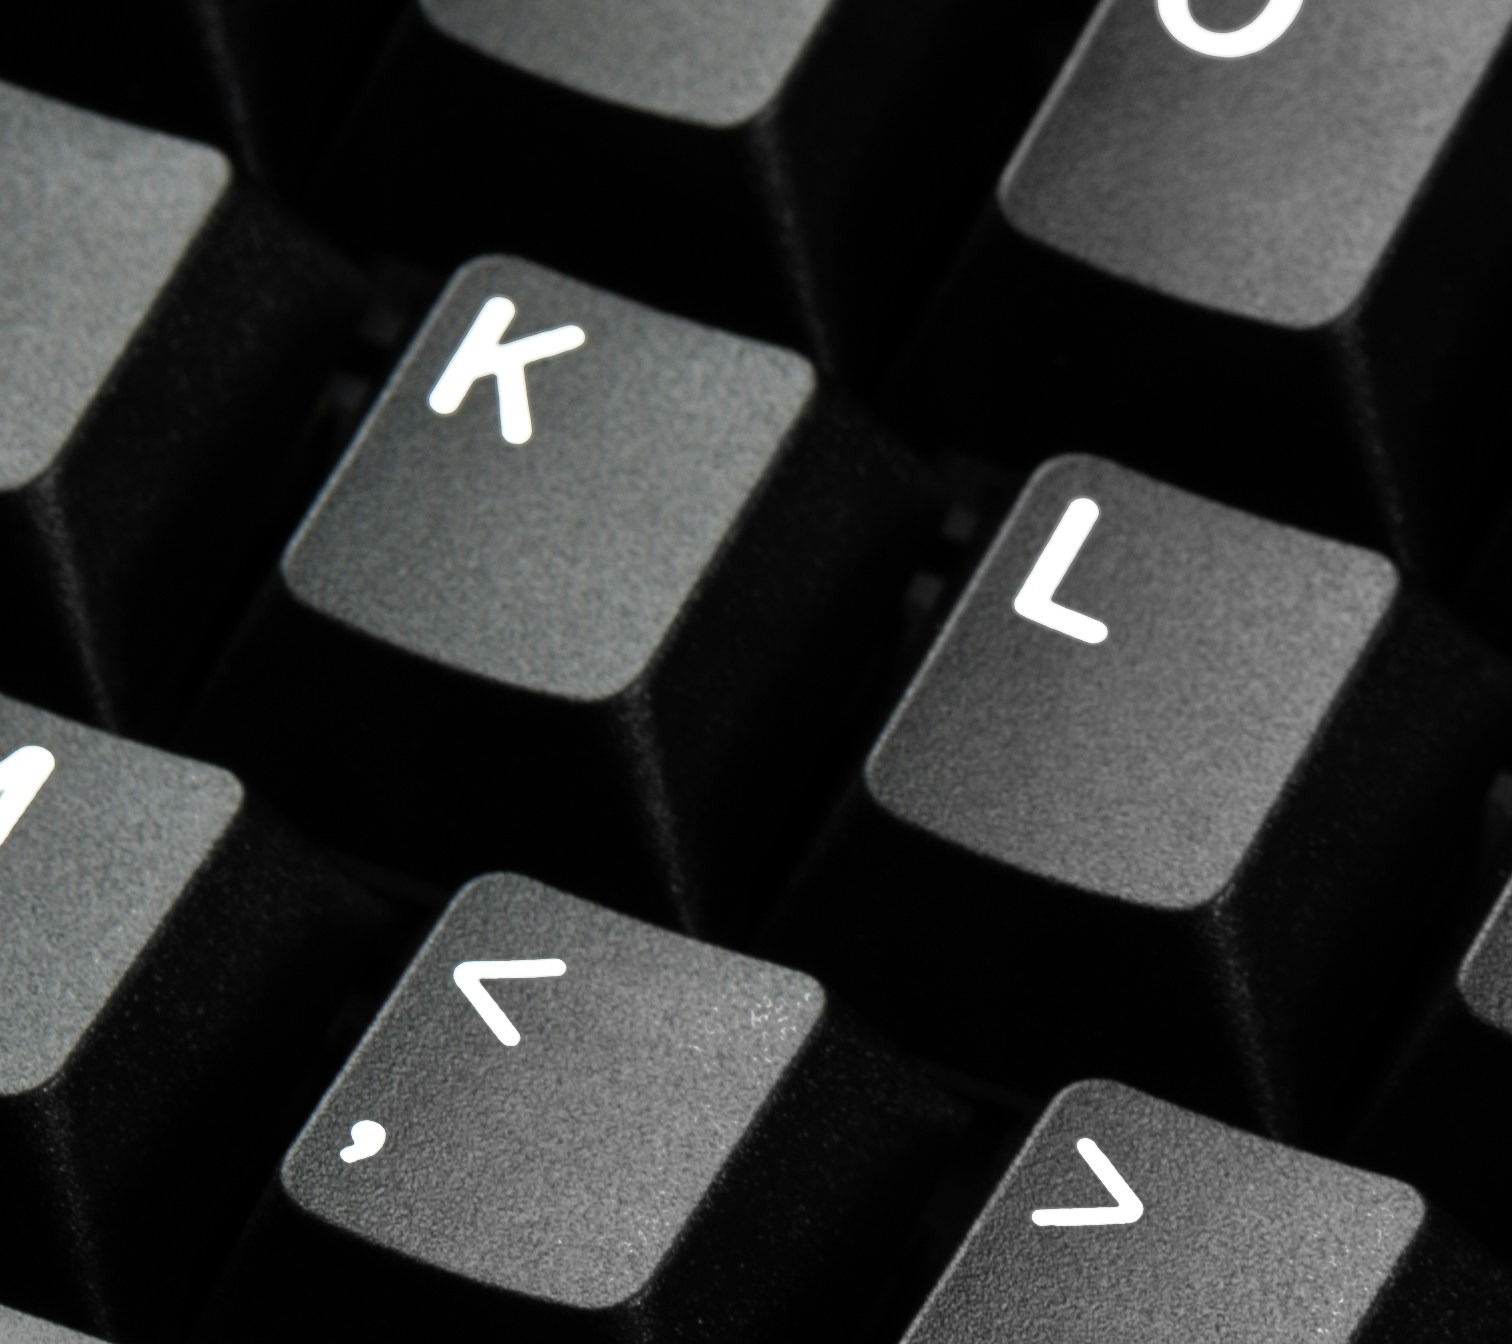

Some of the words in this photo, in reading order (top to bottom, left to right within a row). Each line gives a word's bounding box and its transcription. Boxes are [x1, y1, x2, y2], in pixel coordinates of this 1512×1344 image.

[426, 294, 588, 447] K
[1011, 495, 1111, 647] L
[450, 955, 569, 1049] <
[337, 1117, 389, 1166] ,
[1029, 1135, 1146, 1229] >
